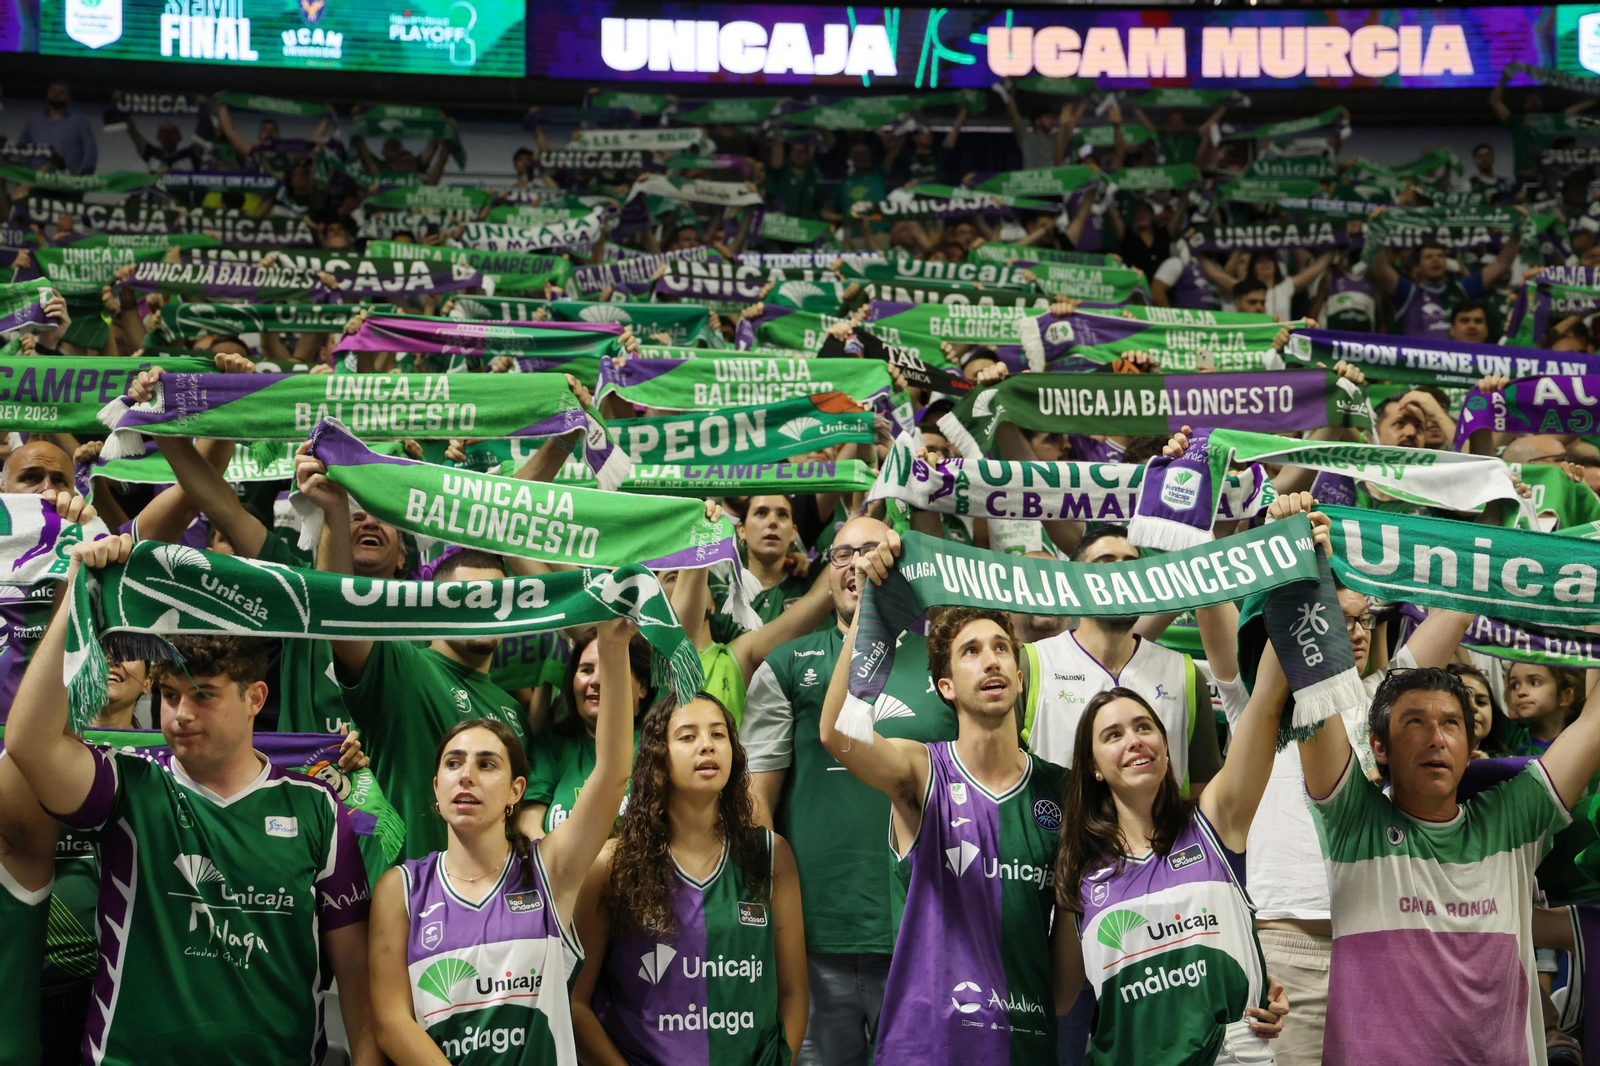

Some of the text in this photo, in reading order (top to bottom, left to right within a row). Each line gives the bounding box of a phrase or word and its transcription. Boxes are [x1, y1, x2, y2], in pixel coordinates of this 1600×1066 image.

[160, 14, 260, 62] FINAL
[281, 28, 344, 49] UCAM
[389, 24, 466, 43] PLAYOFF
[601, 17, 898, 76] UNICAJA
[986, 25, 1475, 79] UCAM MURCIA
[539, 150, 646, 171] UNICAJA
[464, 219, 590, 242] UNICAJA
[1213, 221, 1336, 249] UNICAJA
[62, 248, 136, 273] UNICAJA
[763, 253, 811, 269] TIENE
[135, 262, 314, 289] UNICAJA BALONCES
[1048, 266, 1103, 285] UNICAJA
[276, 305, 361, 326] Unica
[947, 303, 1028, 319] UNICAJA
[929, 316, 1023, 342] BALONCES
[1166, 330, 1246, 353] UNICAJA
[713, 359, 812, 383] UNICAJA
[881, 342, 927, 373] TAU
[1149, 347, 1265, 373] BALOCESTO
[1401, 346, 1473, 375] TIENE
[1475, 352, 1512, 378] UN
[0, 364, 143, 405] CAMPE
[324, 375, 451, 402] UNICAJA
[693, 381, 833, 407] BALONCESTO
[25, 406, 58, 421] 2023
[1037, 385, 1294, 417] UNICAJA BALONCESTO
[1335, 399, 1370, 417] Unicaja
[295, 402, 477, 432] BALONCESTO
[818, 417, 870, 438] Unicaja
[442, 474, 575, 521] UNICAJA
[954, 470, 970, 515] ACB
[986, 492, 1054, 519] C.B.
[405, 488, 600, 561] BALONCESTO
[935, 552, 1082, 608] UNICAJA
[1083, 535, 1298, 608] BALONCESTO
[200, 573, 270, 622] Unicaja
[341, 577, 550, 621] Unicaja
[793, 649, 826, 660] hummel
[857, 639, 886, 680] Unicaja
[1296, 633, 1325, 669] UCB
[1054, 672, 1086, 682] SPALDING
[56, 834, 93, 853] nica
[983, 857, 1056, 891] Unicaja
[1174, 854, 1203, 869] endesa
[221, 884, 295, 911] Unicaja
[508, 898, 524, 908] liga
[511, 901, 541, 912] endesa
[740, 907, 752, 918] liga
[741, 914, 765, 924] endesa
[1147, 907, 1220, 942] Unicaja
[184, 946, 220, 960] Ciudad
[475, 967, 542, 996] Unicaja
[682, 954, 764, 984] Unicaja
[1119, 958, 1208, 1004] málaga
[658, 1003, 755, 1037] málaga
